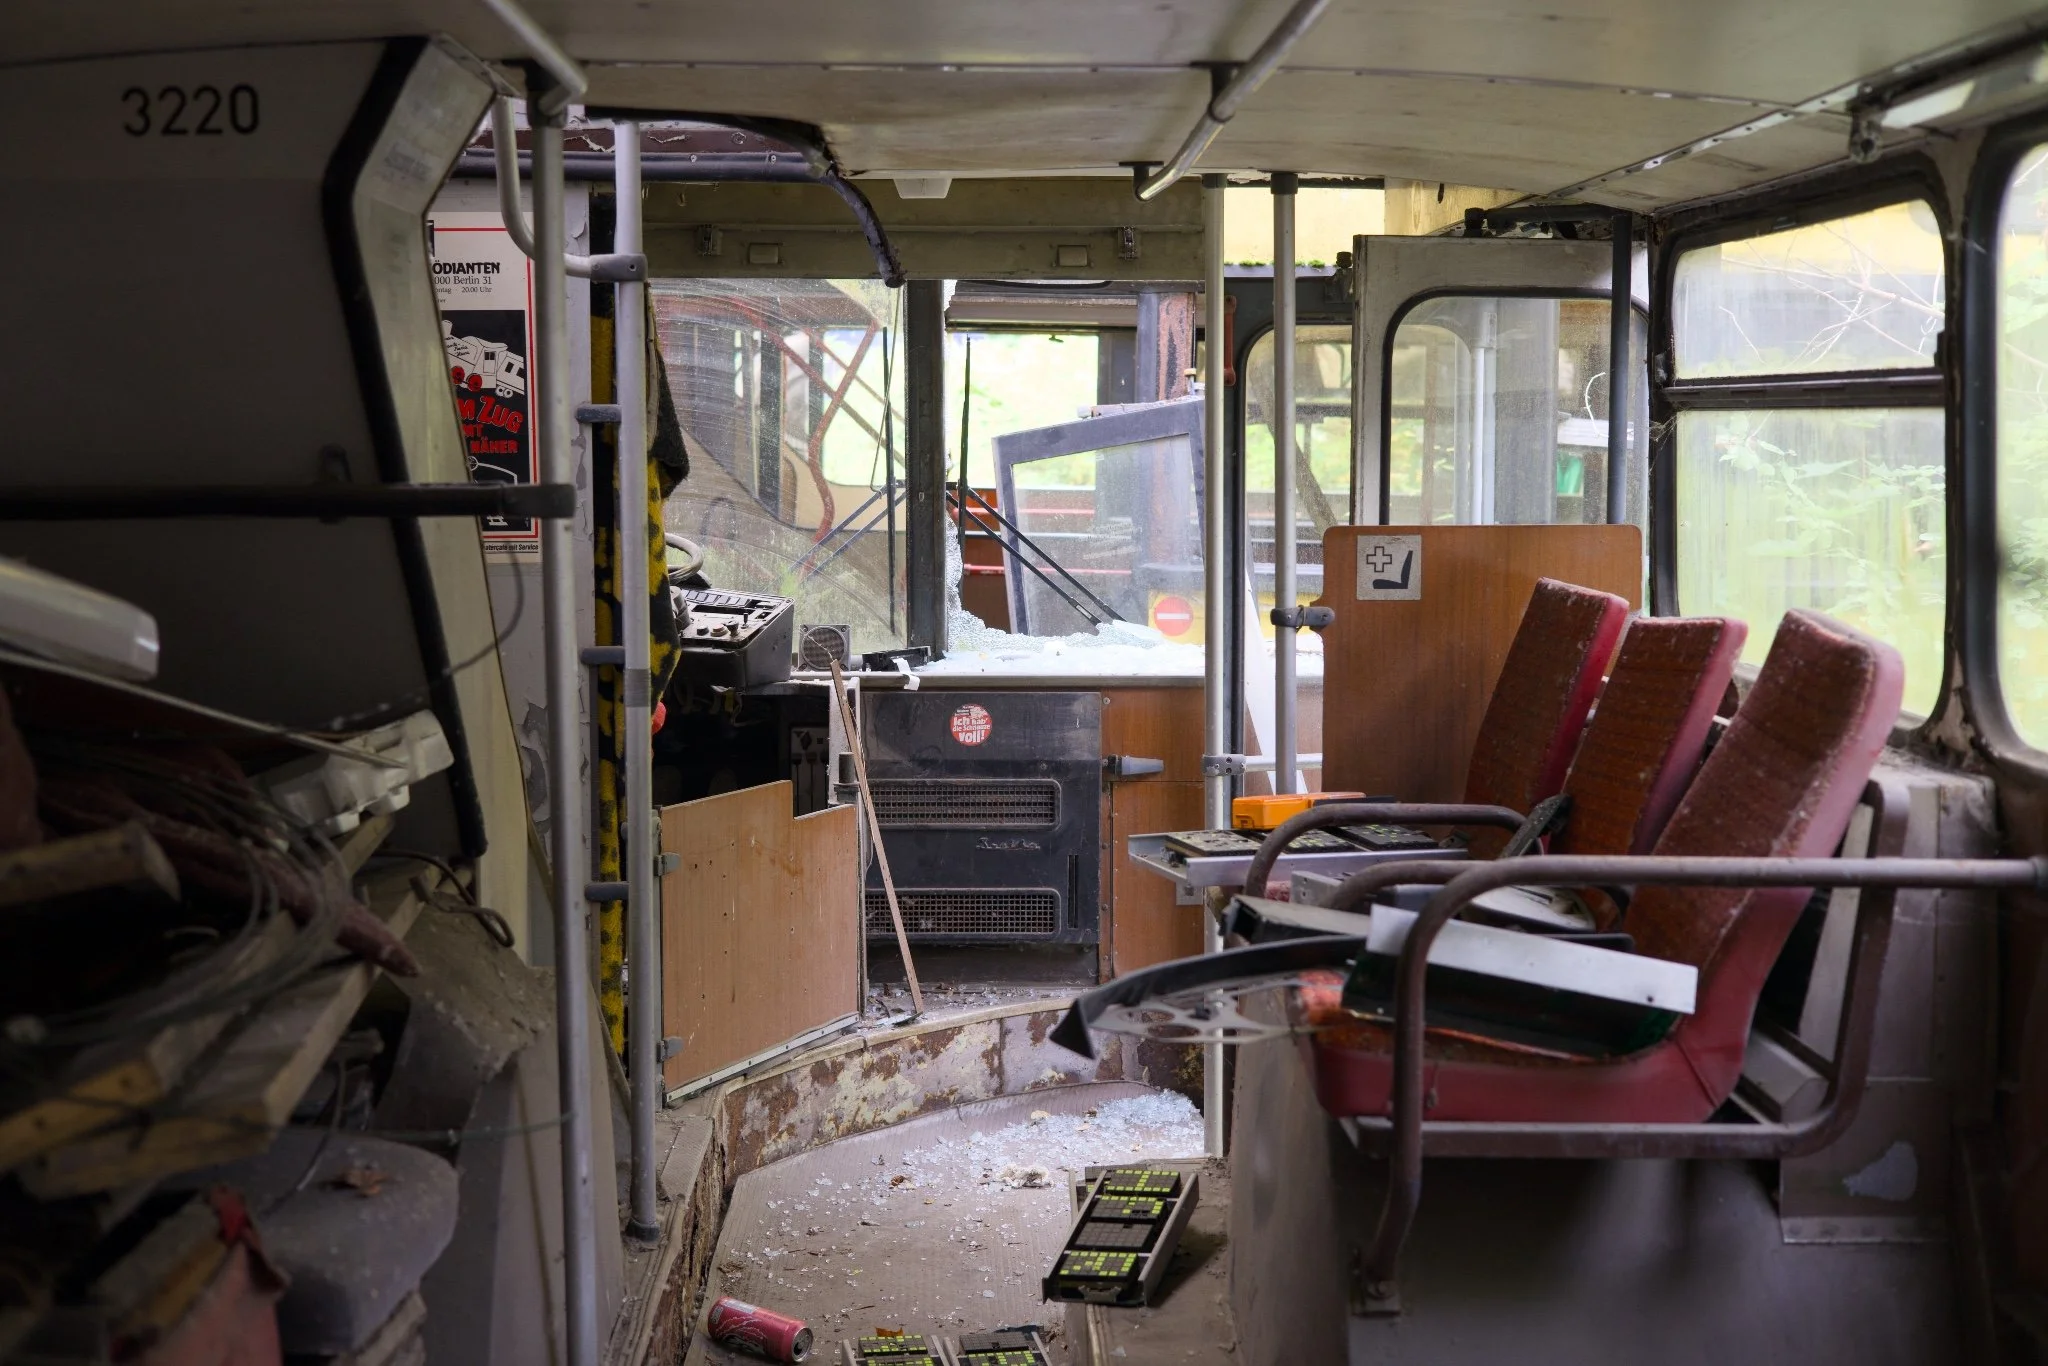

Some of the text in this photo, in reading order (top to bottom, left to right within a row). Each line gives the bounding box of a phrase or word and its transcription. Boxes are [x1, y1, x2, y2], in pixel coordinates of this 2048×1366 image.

[121, 84, 260, 137] 3220
[432, 259, 501, 275] ÖDIANTEN
[434, 276, 493, 285] 000 Berlin 31
[477, 395, 524, 434] ZUG
[518, 543, 539, 551] Service
[958, 729, 985, 743] voll!
